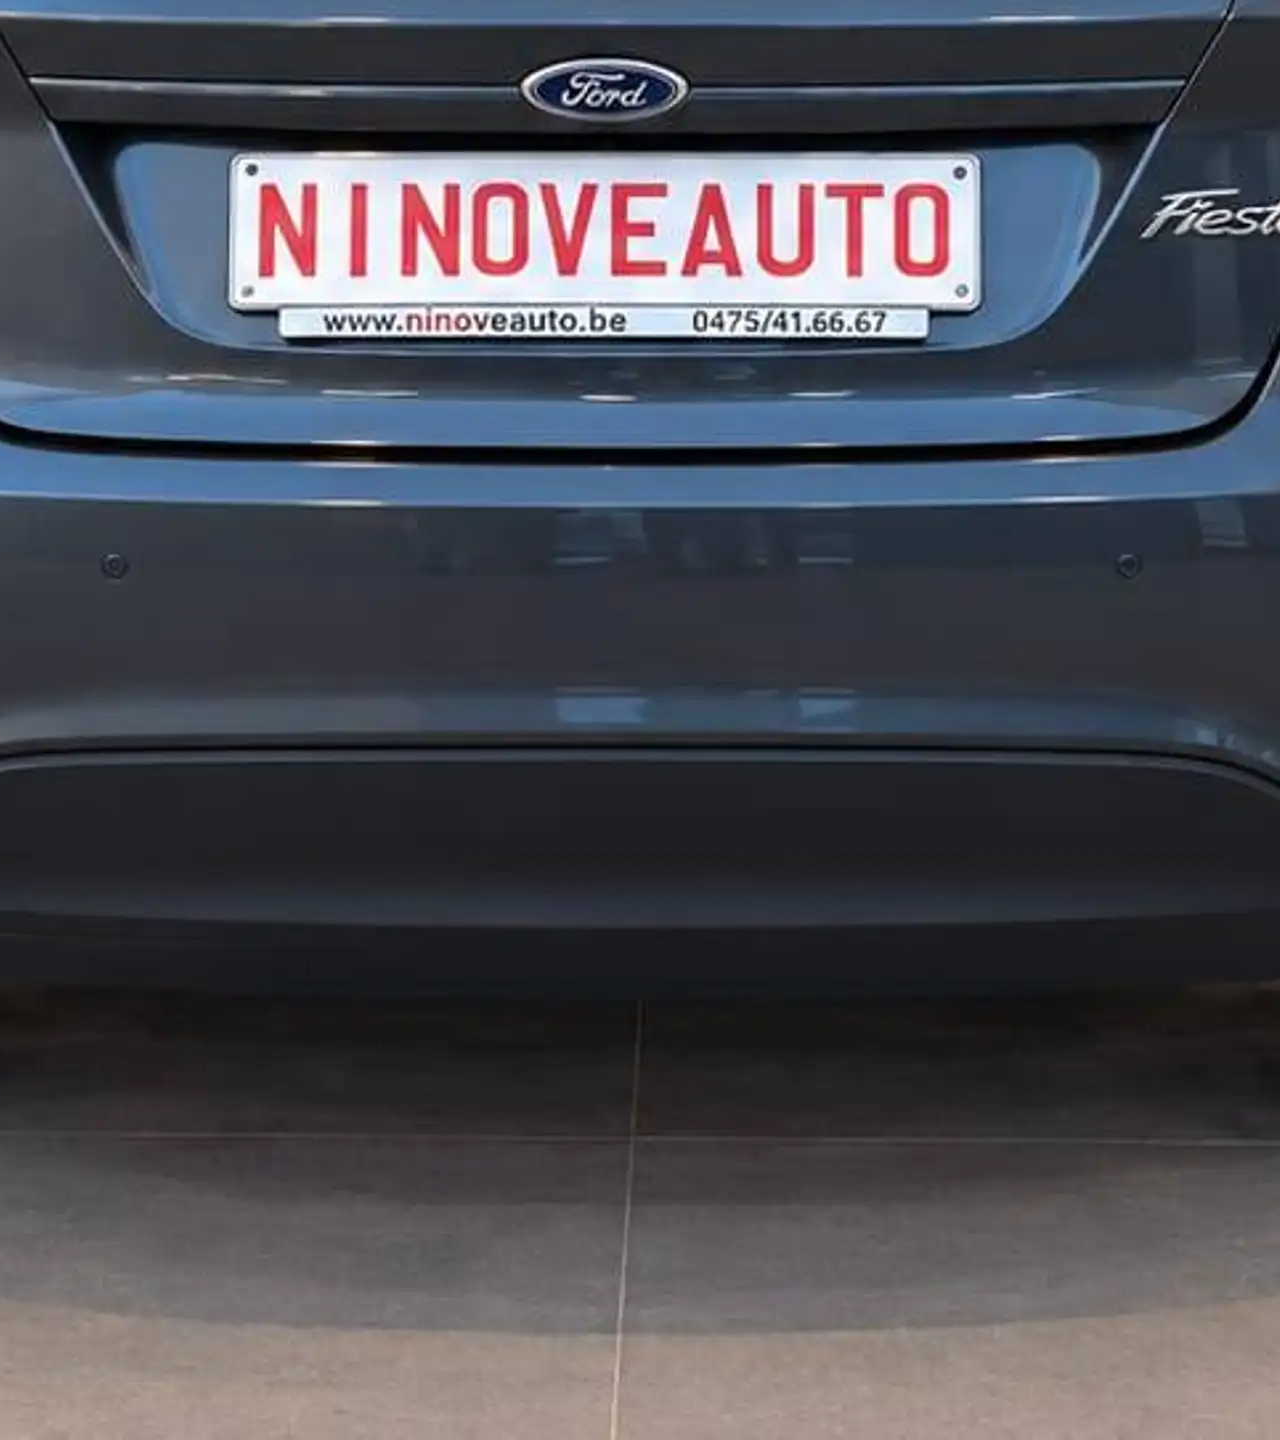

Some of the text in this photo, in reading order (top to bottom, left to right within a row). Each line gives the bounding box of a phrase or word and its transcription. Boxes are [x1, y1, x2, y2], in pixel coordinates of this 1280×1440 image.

[561, 70, 648, 109] Ford
[257, 182, 950, 278] NINOVEAUTO
[322, 307, 887, 334] www.ninoveauto.be 0475/41.66.67
